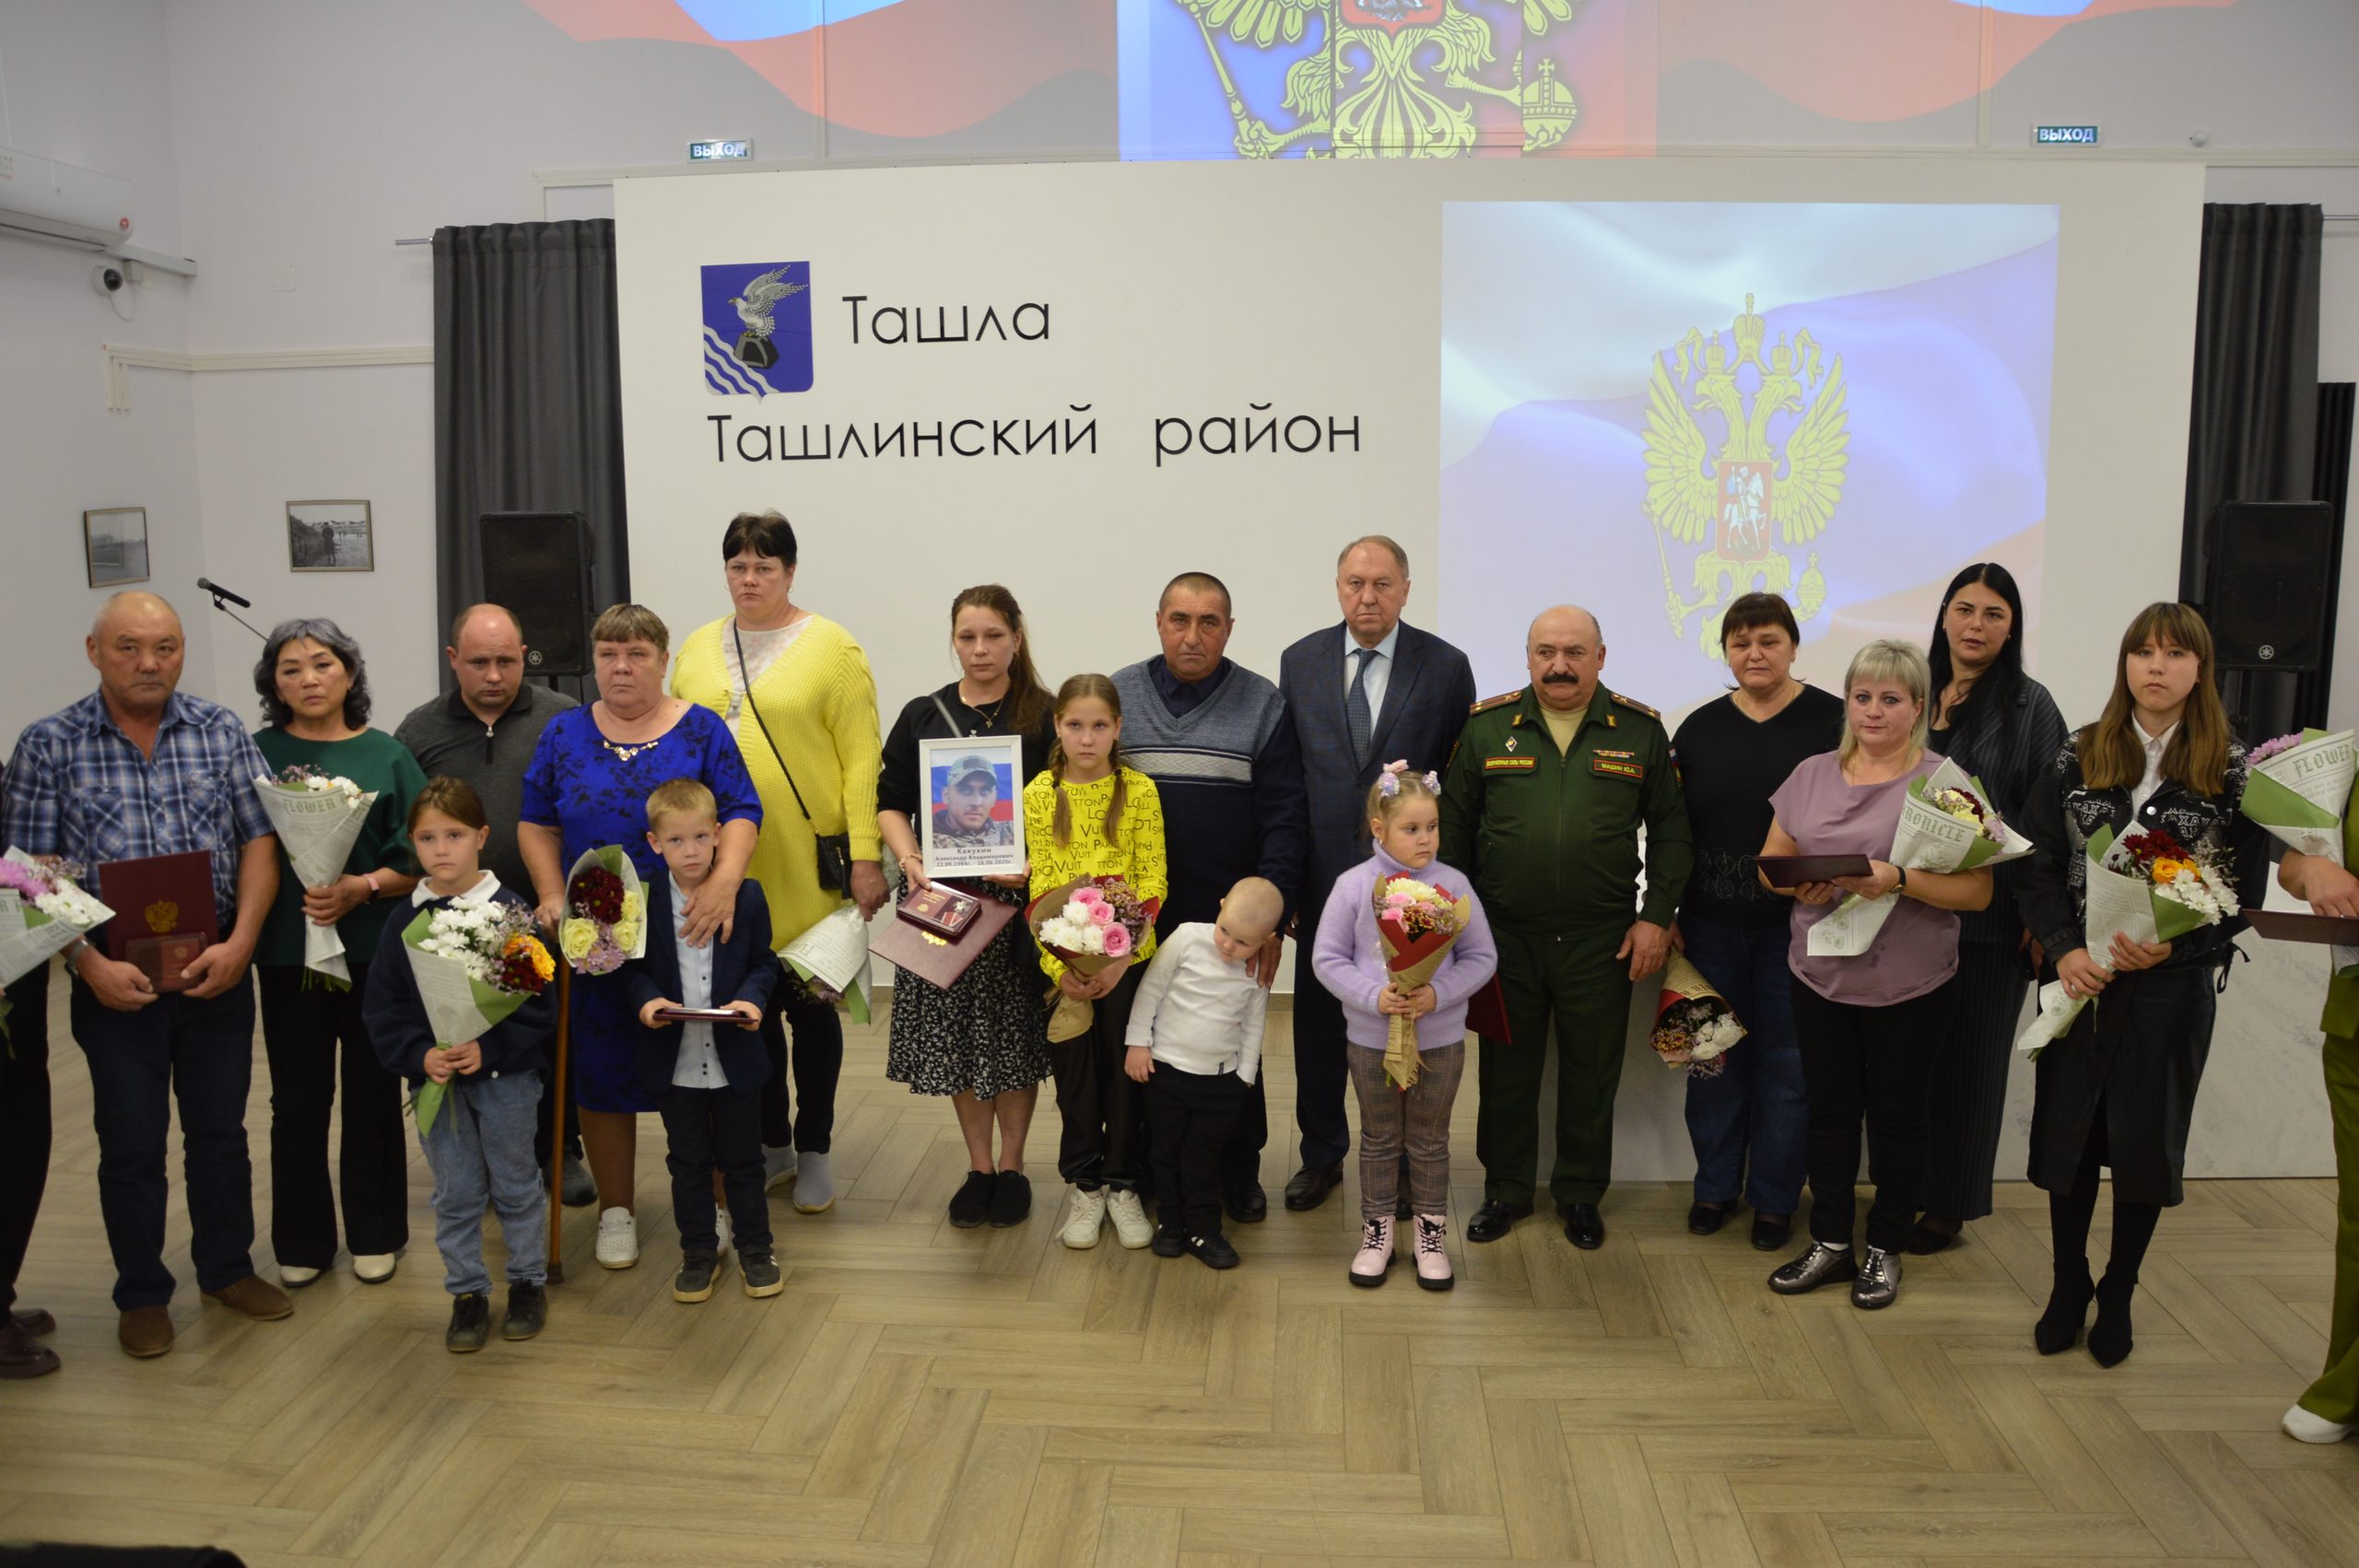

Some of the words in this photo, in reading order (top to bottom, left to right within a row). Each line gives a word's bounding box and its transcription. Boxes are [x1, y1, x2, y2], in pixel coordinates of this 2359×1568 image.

[2039, 128, 2095, 143] ВЫХОД
[692, 143, 745, 158] ВЫХОД
[842, 296, 1050, 345] Ташла
[707, 404, 1097, 462] Ташлинский
[1156, 403, 1360, 467] район
[282, 797, 336, 813] FLOWER
[957, 848, 992, 856] Какухин
